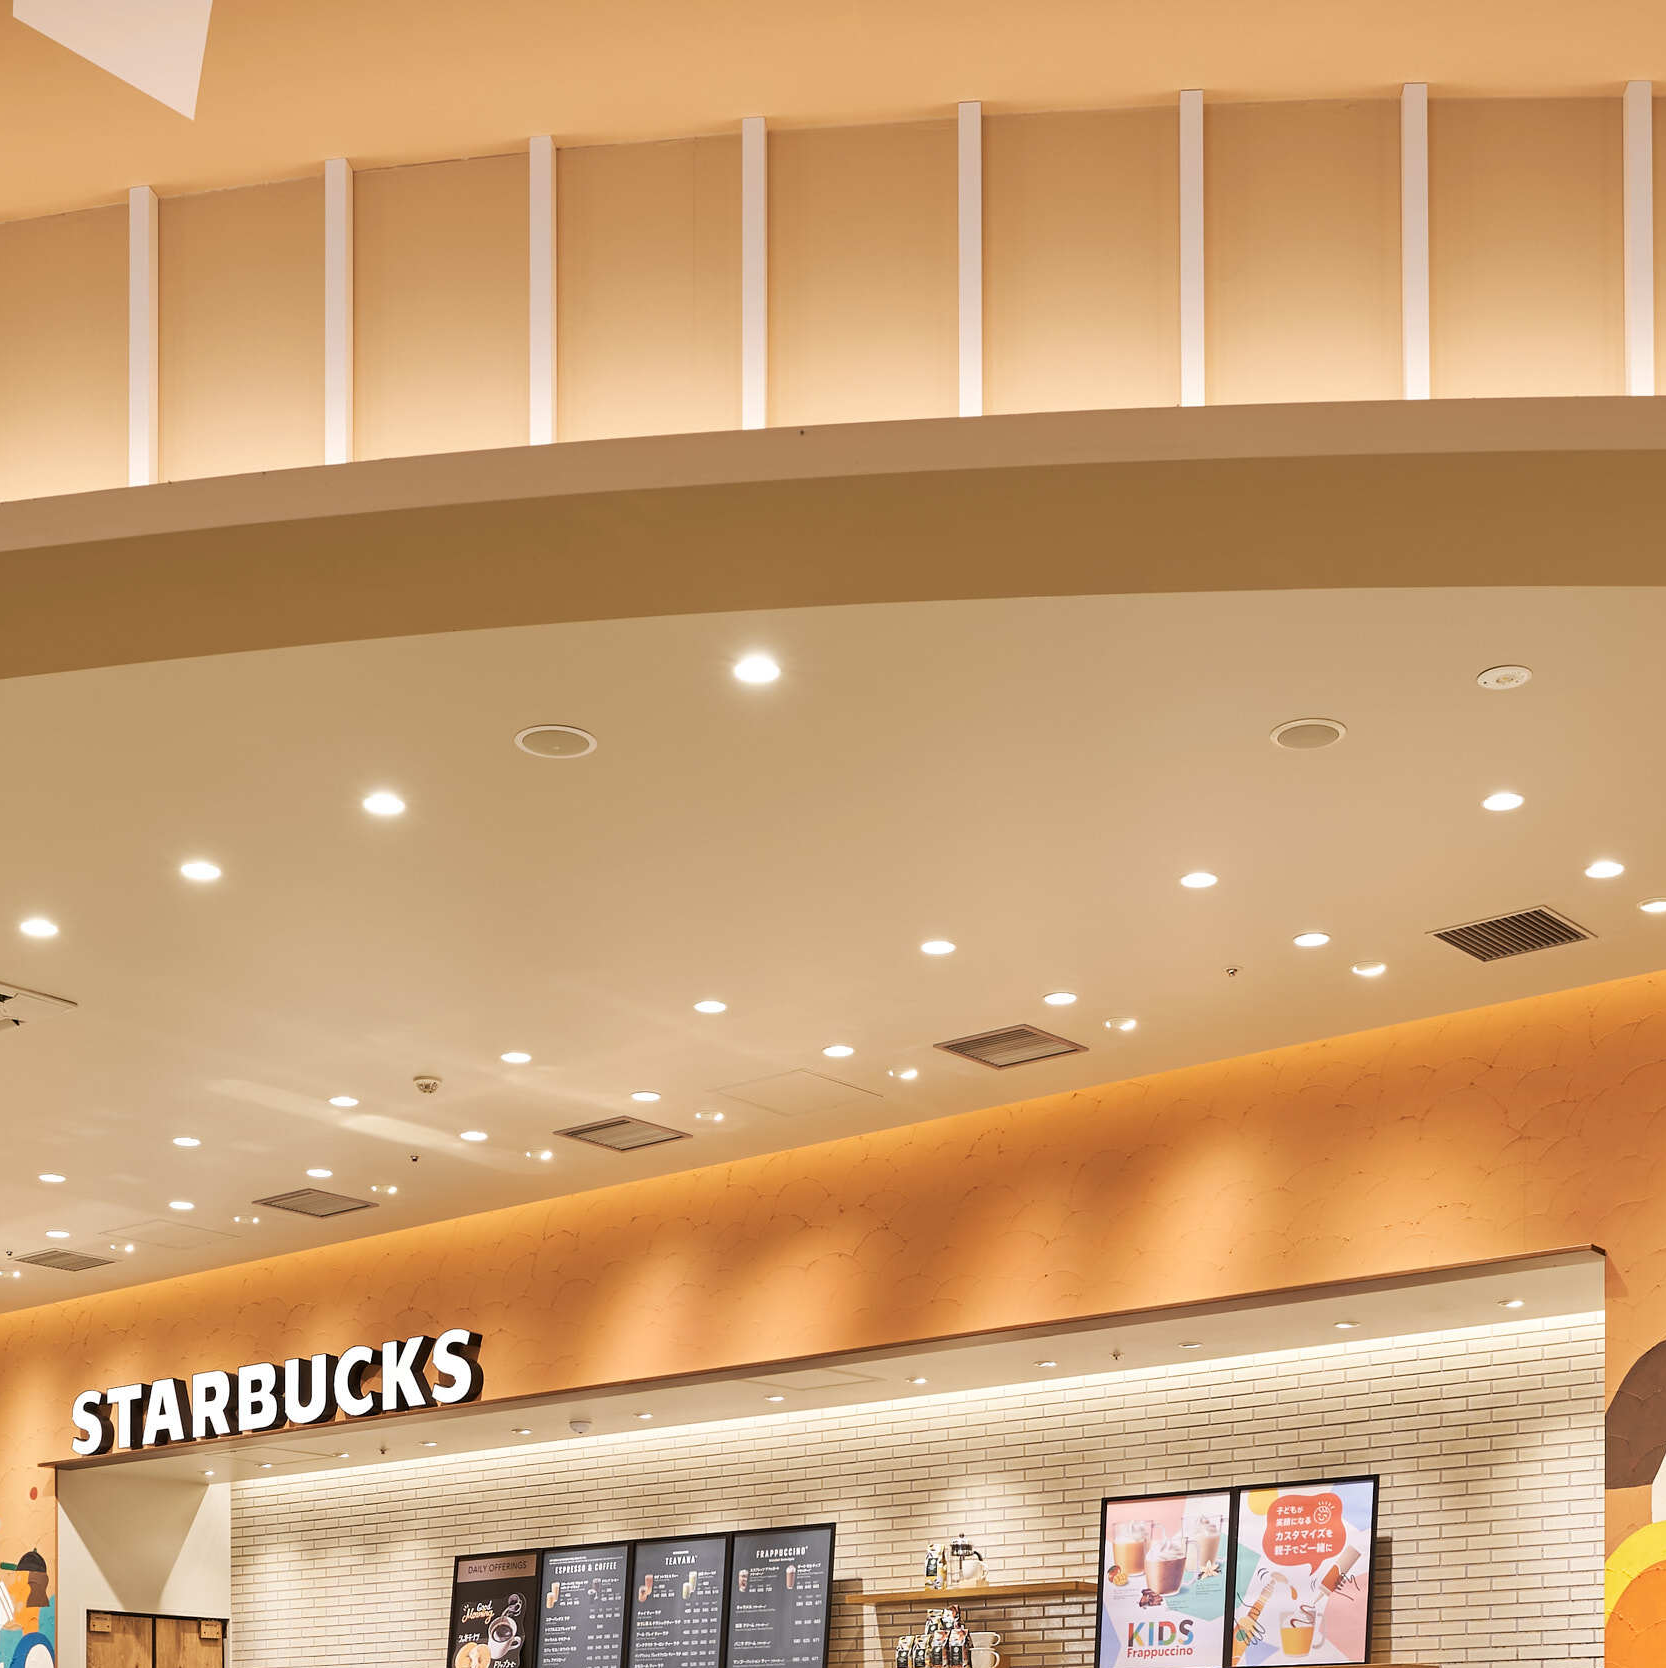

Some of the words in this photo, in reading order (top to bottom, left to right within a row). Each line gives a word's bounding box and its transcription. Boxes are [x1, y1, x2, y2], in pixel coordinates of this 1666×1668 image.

[71, 1328, 482, 1456] STARBUCKS
[1275, 1528, 1333, 1541] カスタマイズを
[468, 1563, 489, 1575] DAILY
[489, 1560, 527, 1573] OFFERINGS
[554, 1564, 586, 1575] ESPRESSO
[594, 1561, 617, 1571] COFFEE
[476, 1600, 493, 1612] Good
[461, 1608, 495, 1625] Morning
[1127, 1619, 1194, 1647] KIDS
[1127, 1646, 1194, 1659] Frappuccino
